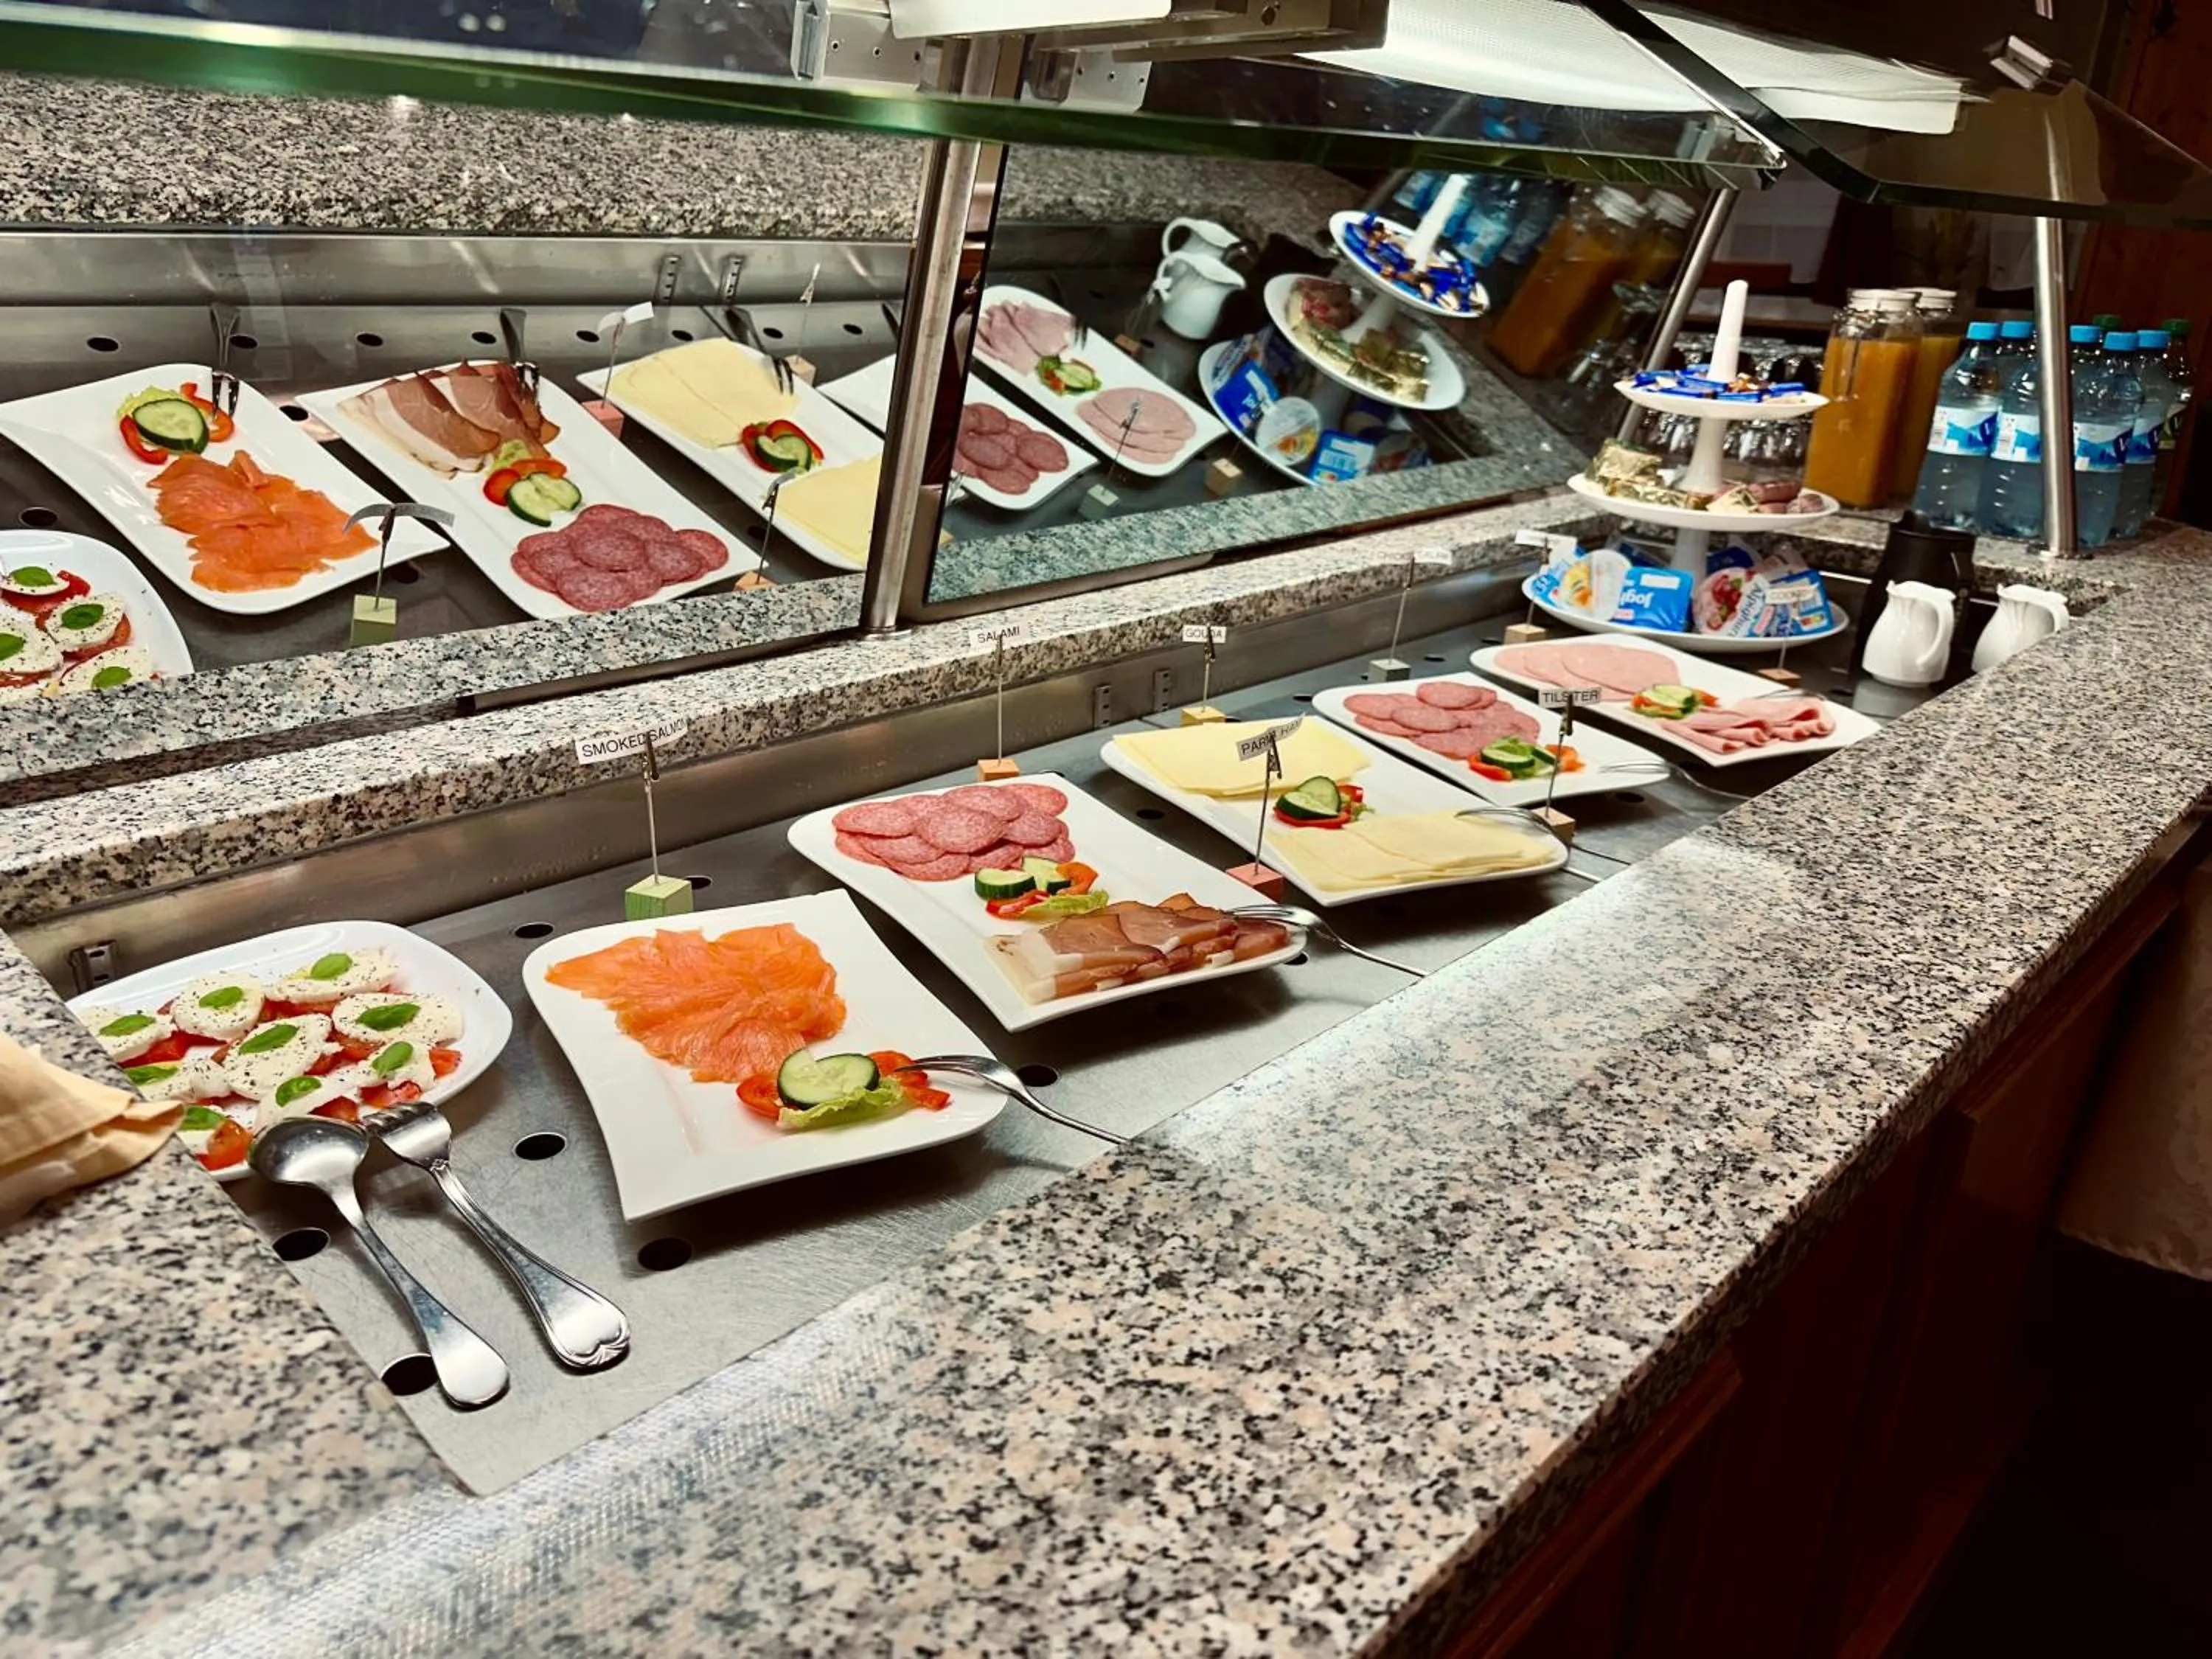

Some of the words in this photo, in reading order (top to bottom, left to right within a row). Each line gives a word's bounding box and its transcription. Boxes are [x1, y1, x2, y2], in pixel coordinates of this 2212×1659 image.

[977, 625, 1020, 644] SALAMI
[1185, 627, 1222, 639] GOUDA
[581, 731, 648, 757] SMOKED
